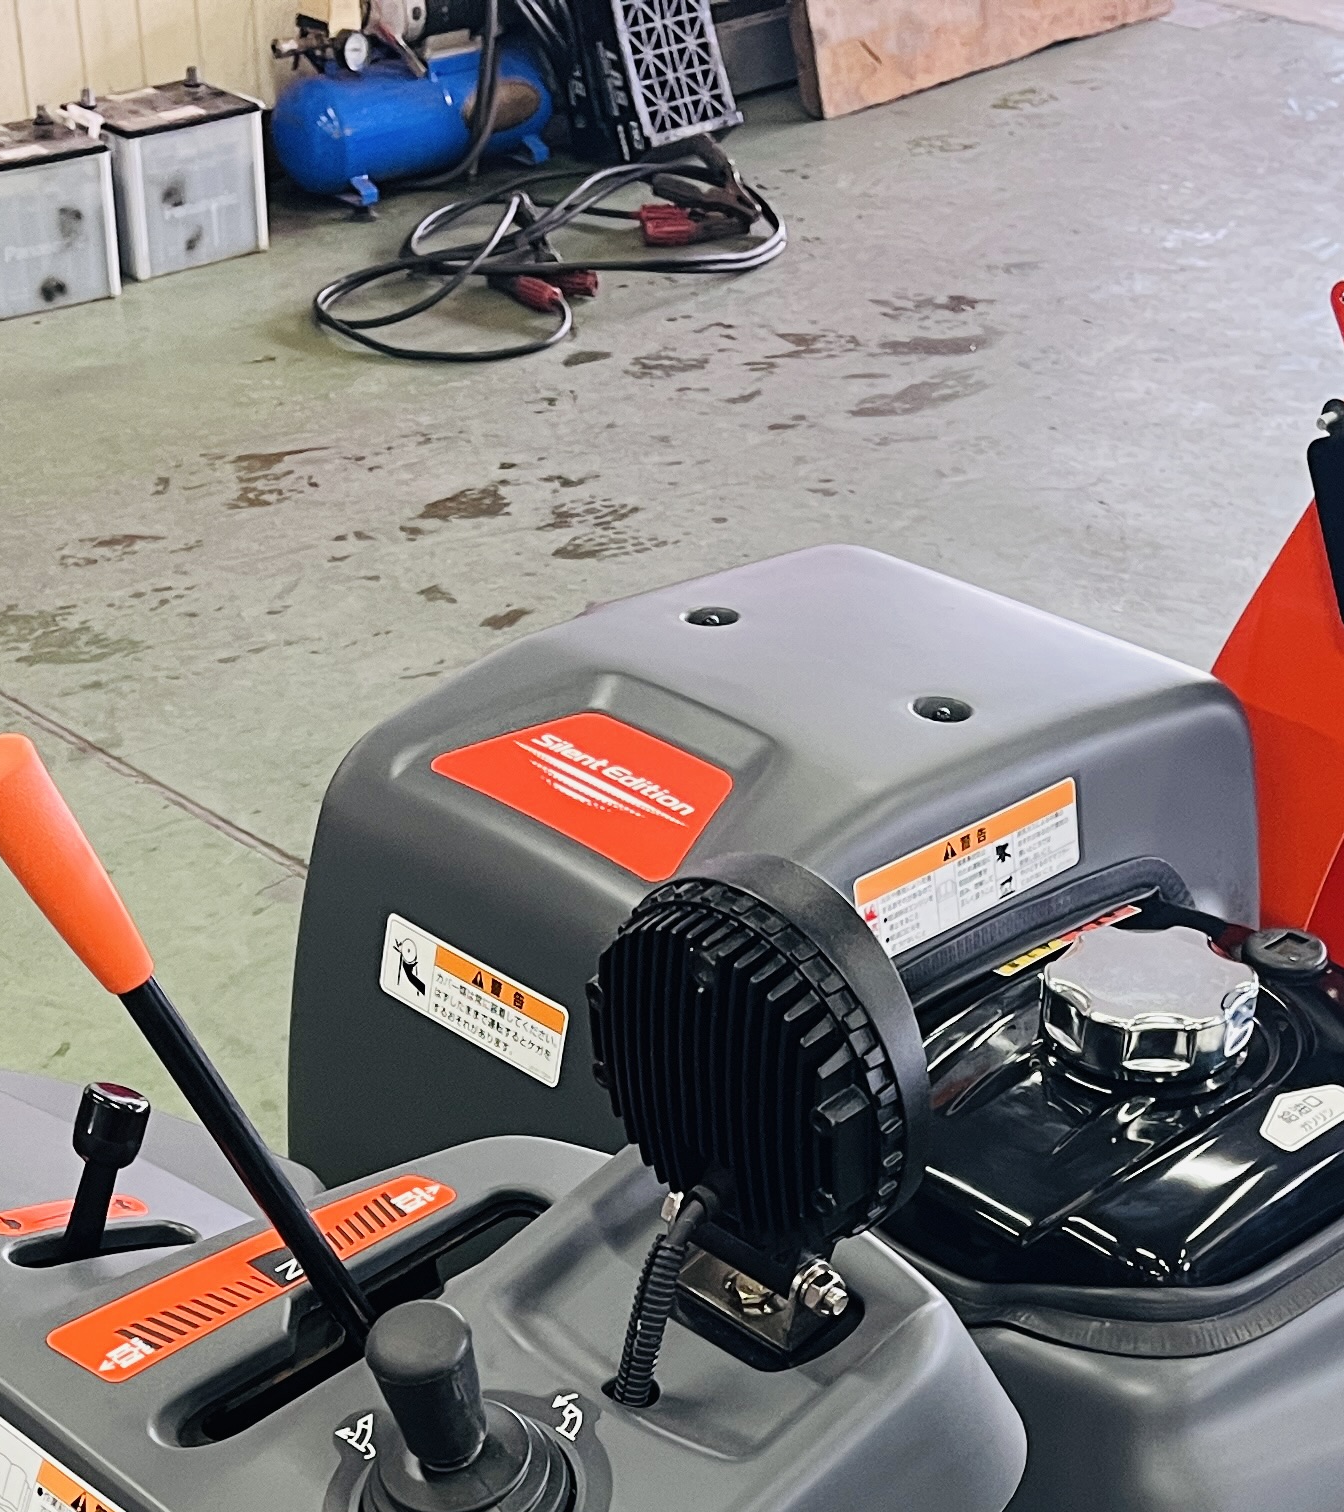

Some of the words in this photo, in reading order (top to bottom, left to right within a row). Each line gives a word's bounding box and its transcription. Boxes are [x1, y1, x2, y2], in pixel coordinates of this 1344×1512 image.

[531, 734, 610, 771] Silent
[602, 765, 696, 817] Edition
[1277, 1095, 1324, 1124] 給油口
[1300, 1107, 1334, 1132] ガソリン
[276, 1259, 304, 1281] N
